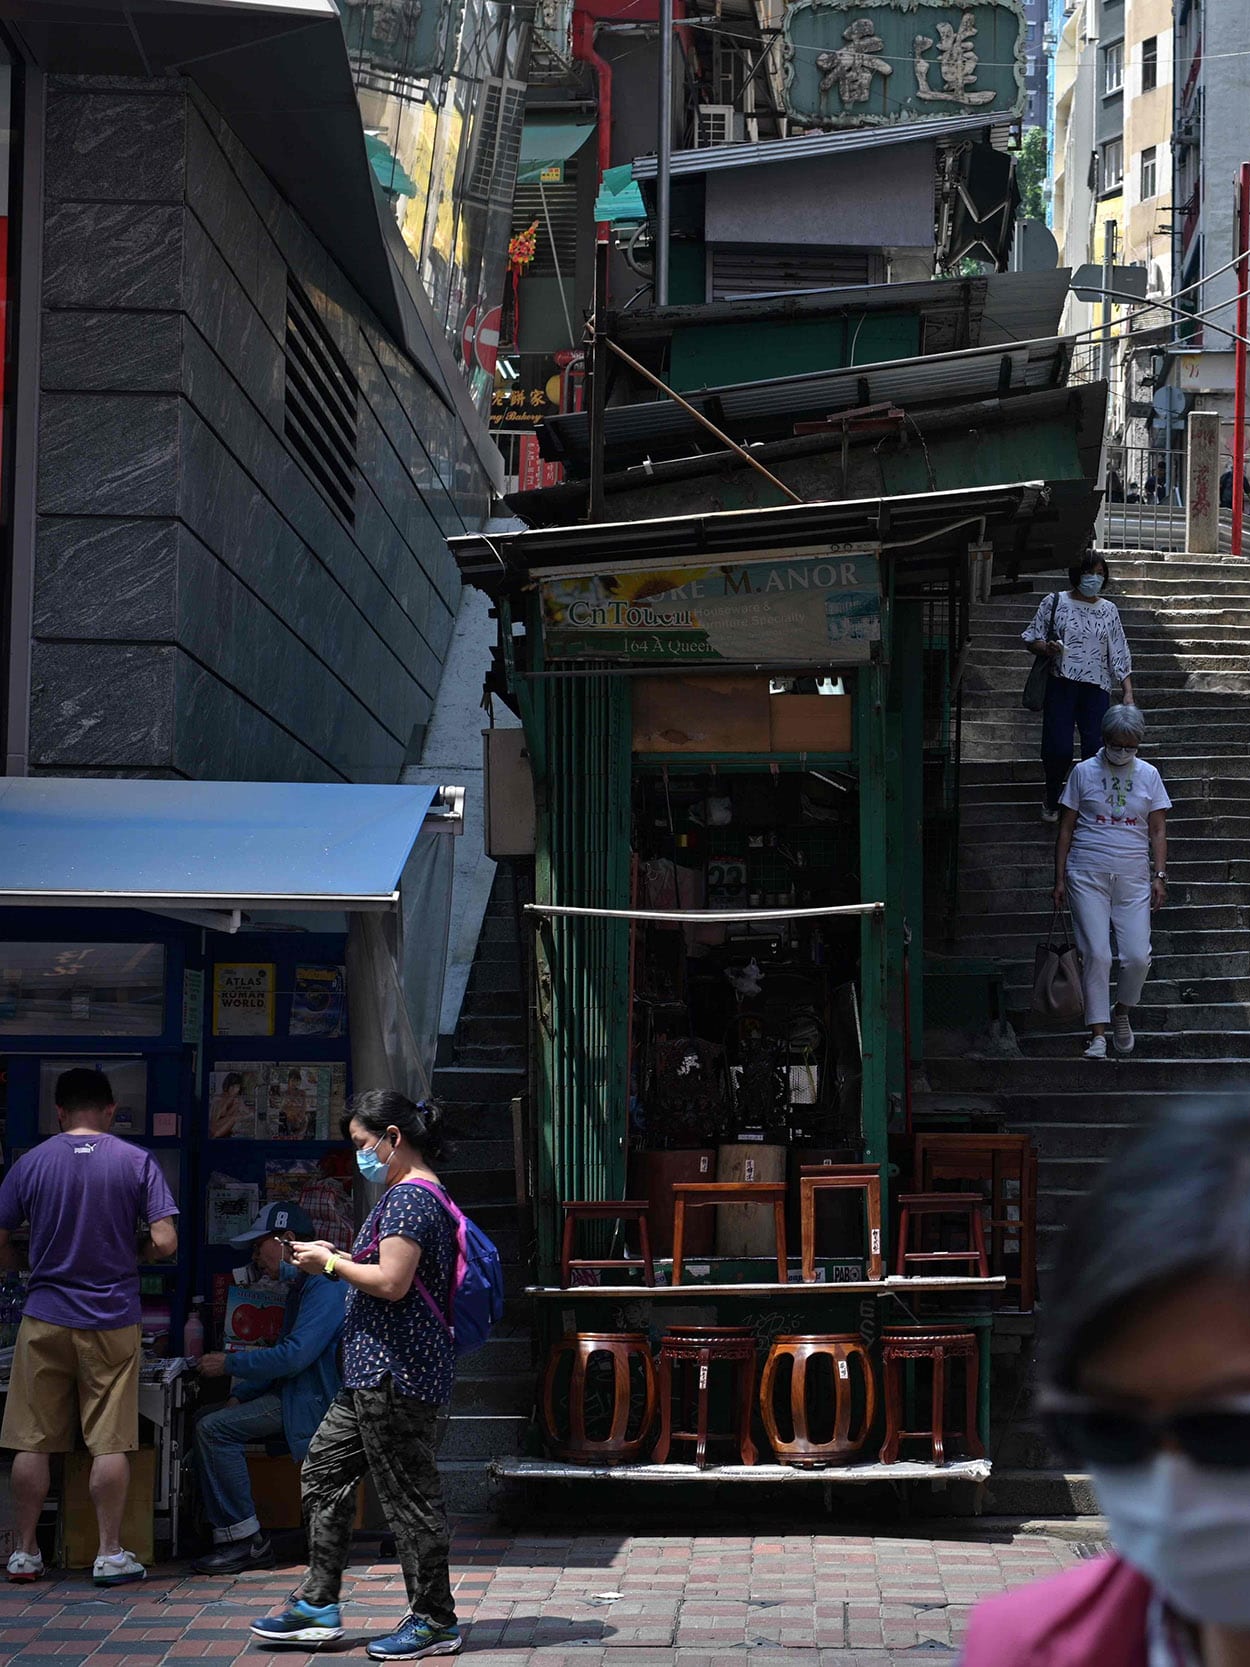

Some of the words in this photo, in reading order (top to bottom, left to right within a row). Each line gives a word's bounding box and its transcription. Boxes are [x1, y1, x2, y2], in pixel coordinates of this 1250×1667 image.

[505, 411, 544, 424] Bakery
[703, 616, 749, 630] urniture
[622, 640, 649, 655] 164
[225, 977, 262, 986] ATLAS
[221, 999, 265, 1008] WORLD
[274, 1210, 289, 1229] 8
